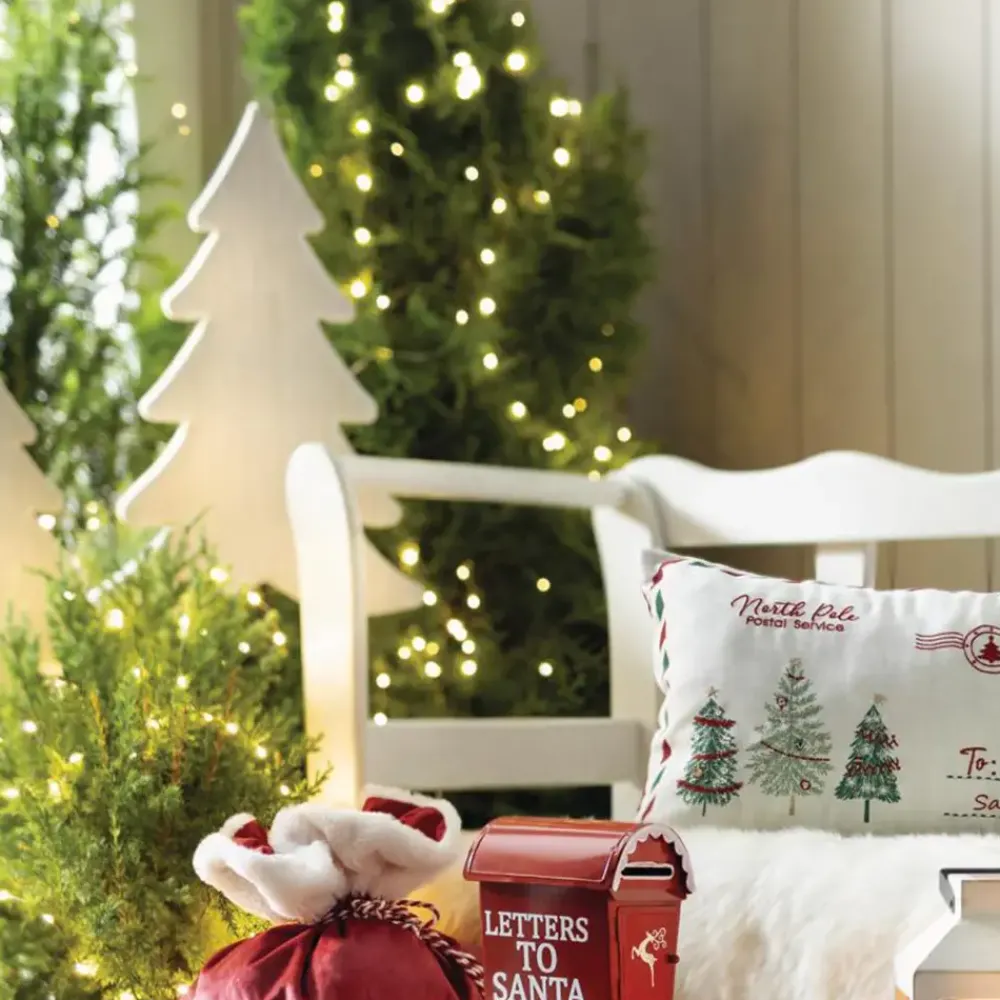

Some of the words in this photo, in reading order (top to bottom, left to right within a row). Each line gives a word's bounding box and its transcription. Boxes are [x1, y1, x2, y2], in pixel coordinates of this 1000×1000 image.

[730, 594, 806, 617] North
[811, 603, 860, 621] Pole
[745, 615, 788, 629] Postal
[793, 619, 845, 632] Service
[959, 746, 997, 776] To:
[484, 910, 589, 942] LETTERS
[516, 941, 558, 974] TO
